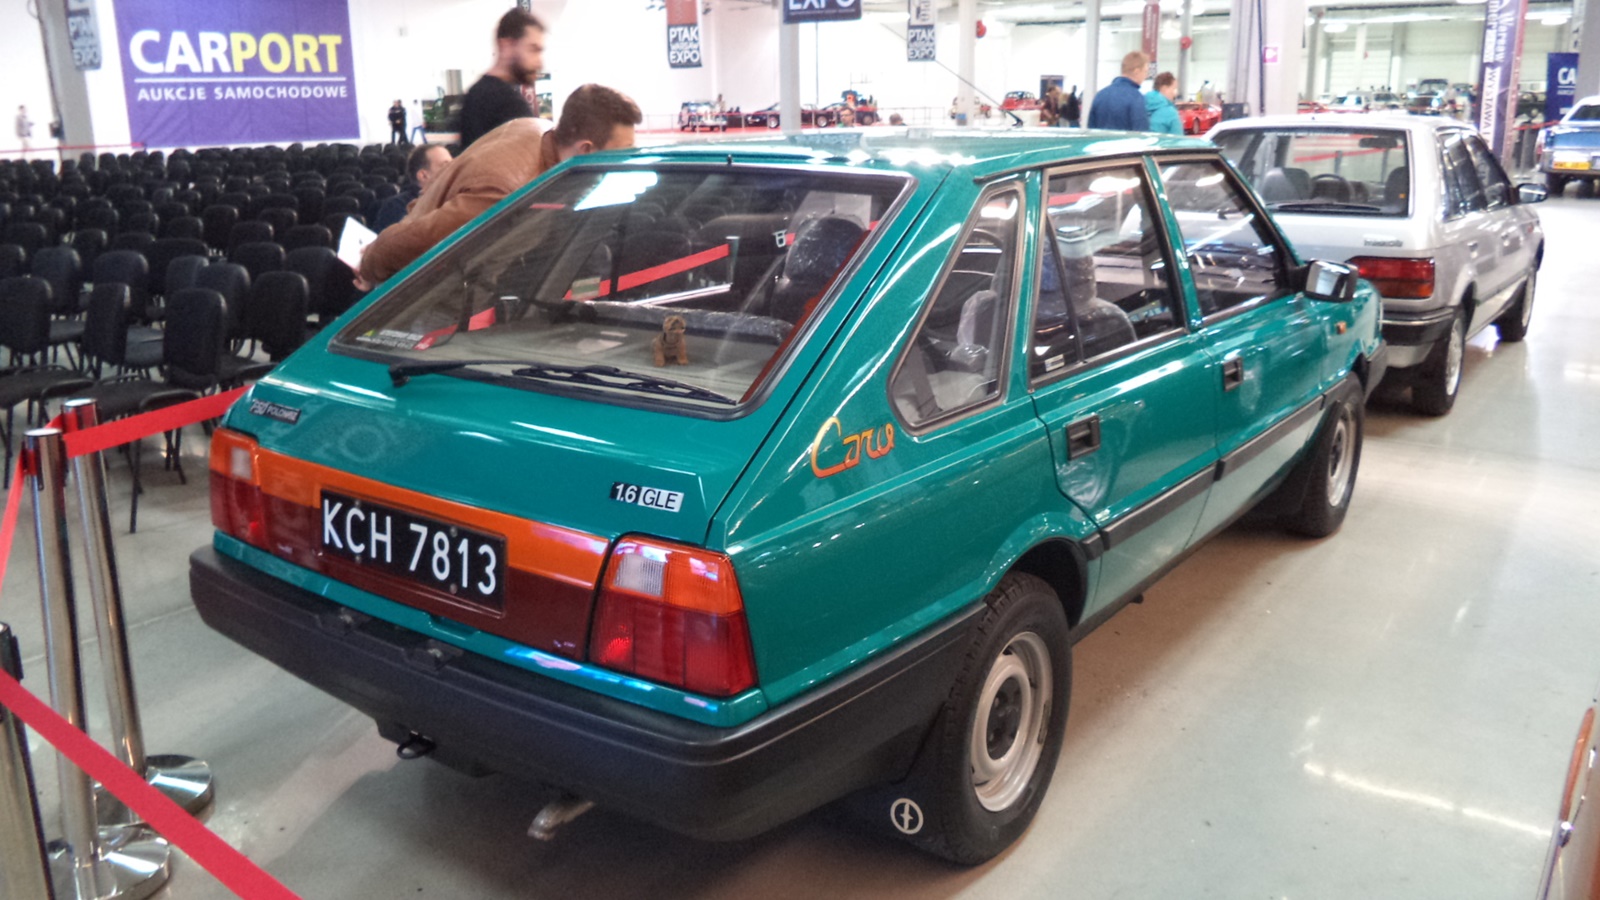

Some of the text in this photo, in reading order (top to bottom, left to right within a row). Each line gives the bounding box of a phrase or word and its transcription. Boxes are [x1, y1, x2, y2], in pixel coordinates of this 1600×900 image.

[670, 27, 699, 43] PTAK
[908, 29, 935, 43] PTAK
[129, 30, 342, 74] CARPORT
[670, 50, 700, 63] EXPO
[138, 85, 348, 101] AUKCJE SAMOCHODOWE
[1482, 70, 1497, 131] WYSTAWA
[616, 483, 679, 509] 1.6 GLE
[323, 499, 496, 595] KCH 7813
